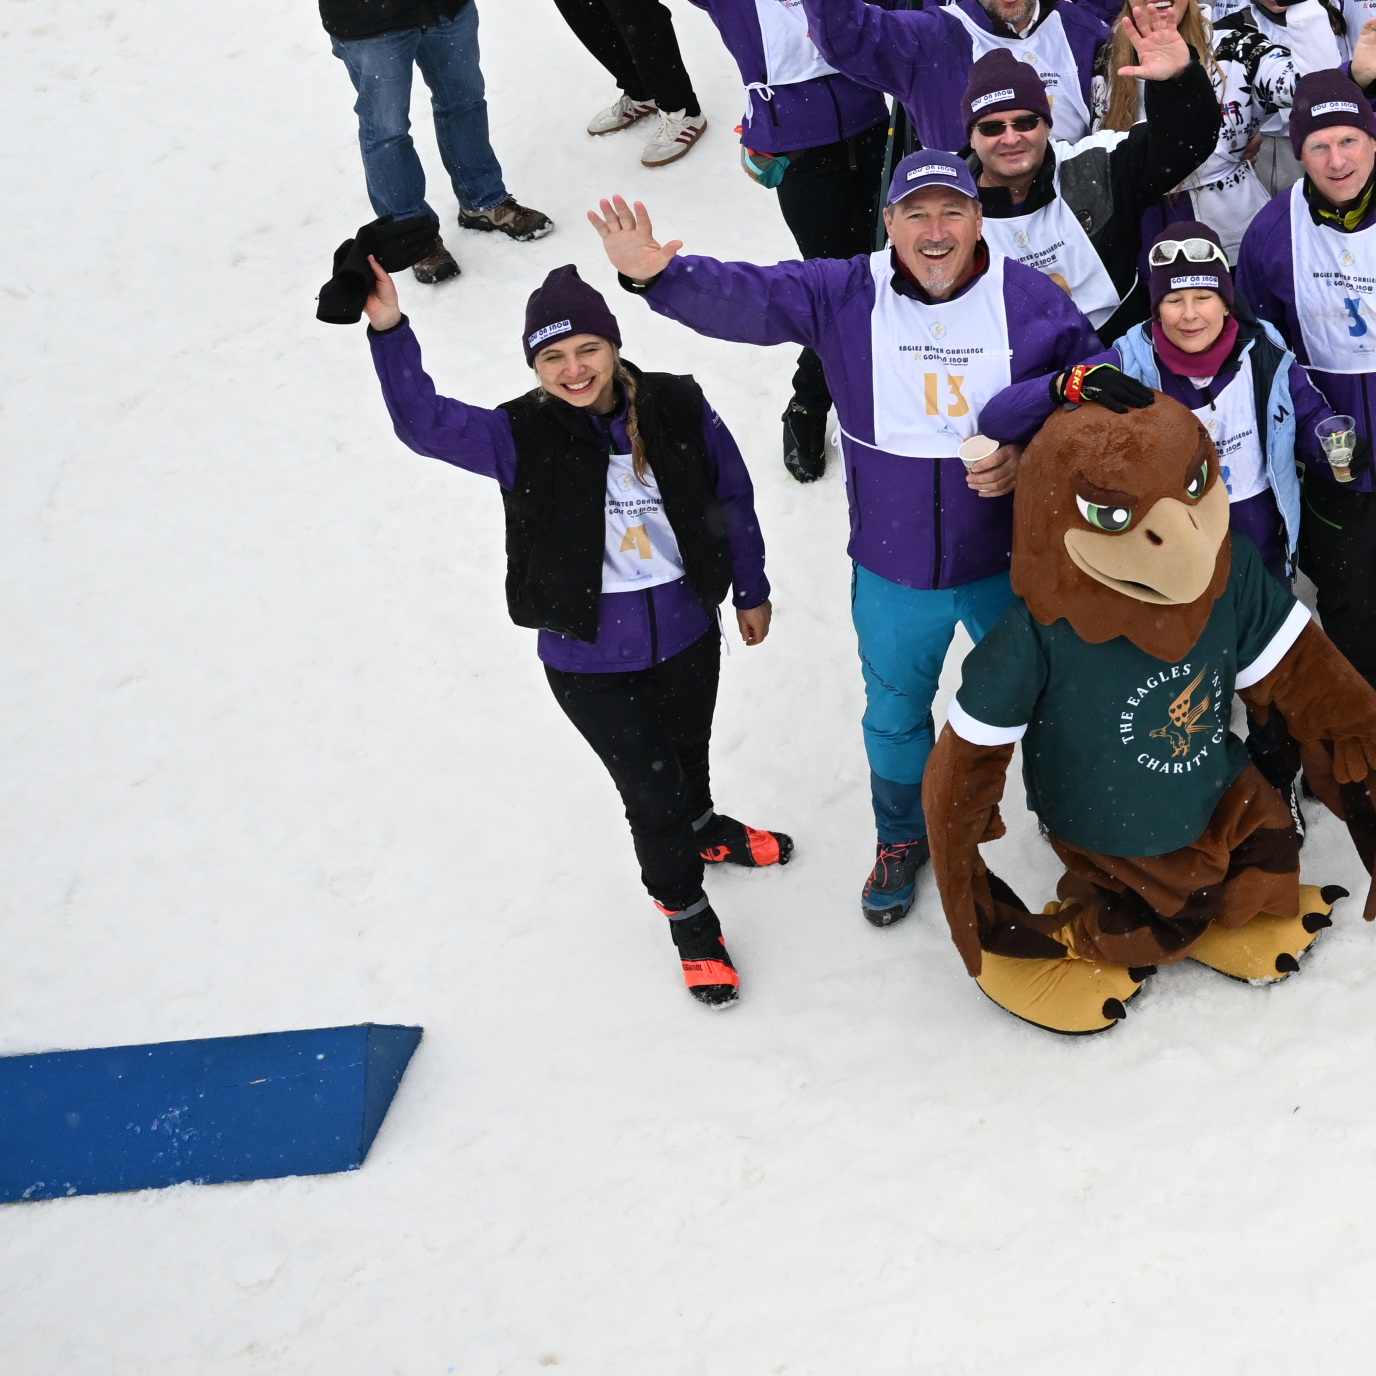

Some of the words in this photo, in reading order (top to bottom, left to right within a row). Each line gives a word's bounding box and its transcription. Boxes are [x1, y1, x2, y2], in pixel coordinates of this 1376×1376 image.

[1348, 297, 1368, 338] 3
[923, 372, 970, 417] 13
[619, 523, 654, 560] 4
[1126, 663, 1191, 707] EAGLES
[1119, 711, 1135, 745] THE
[1137, 745, 1210, 774] CHARITY
